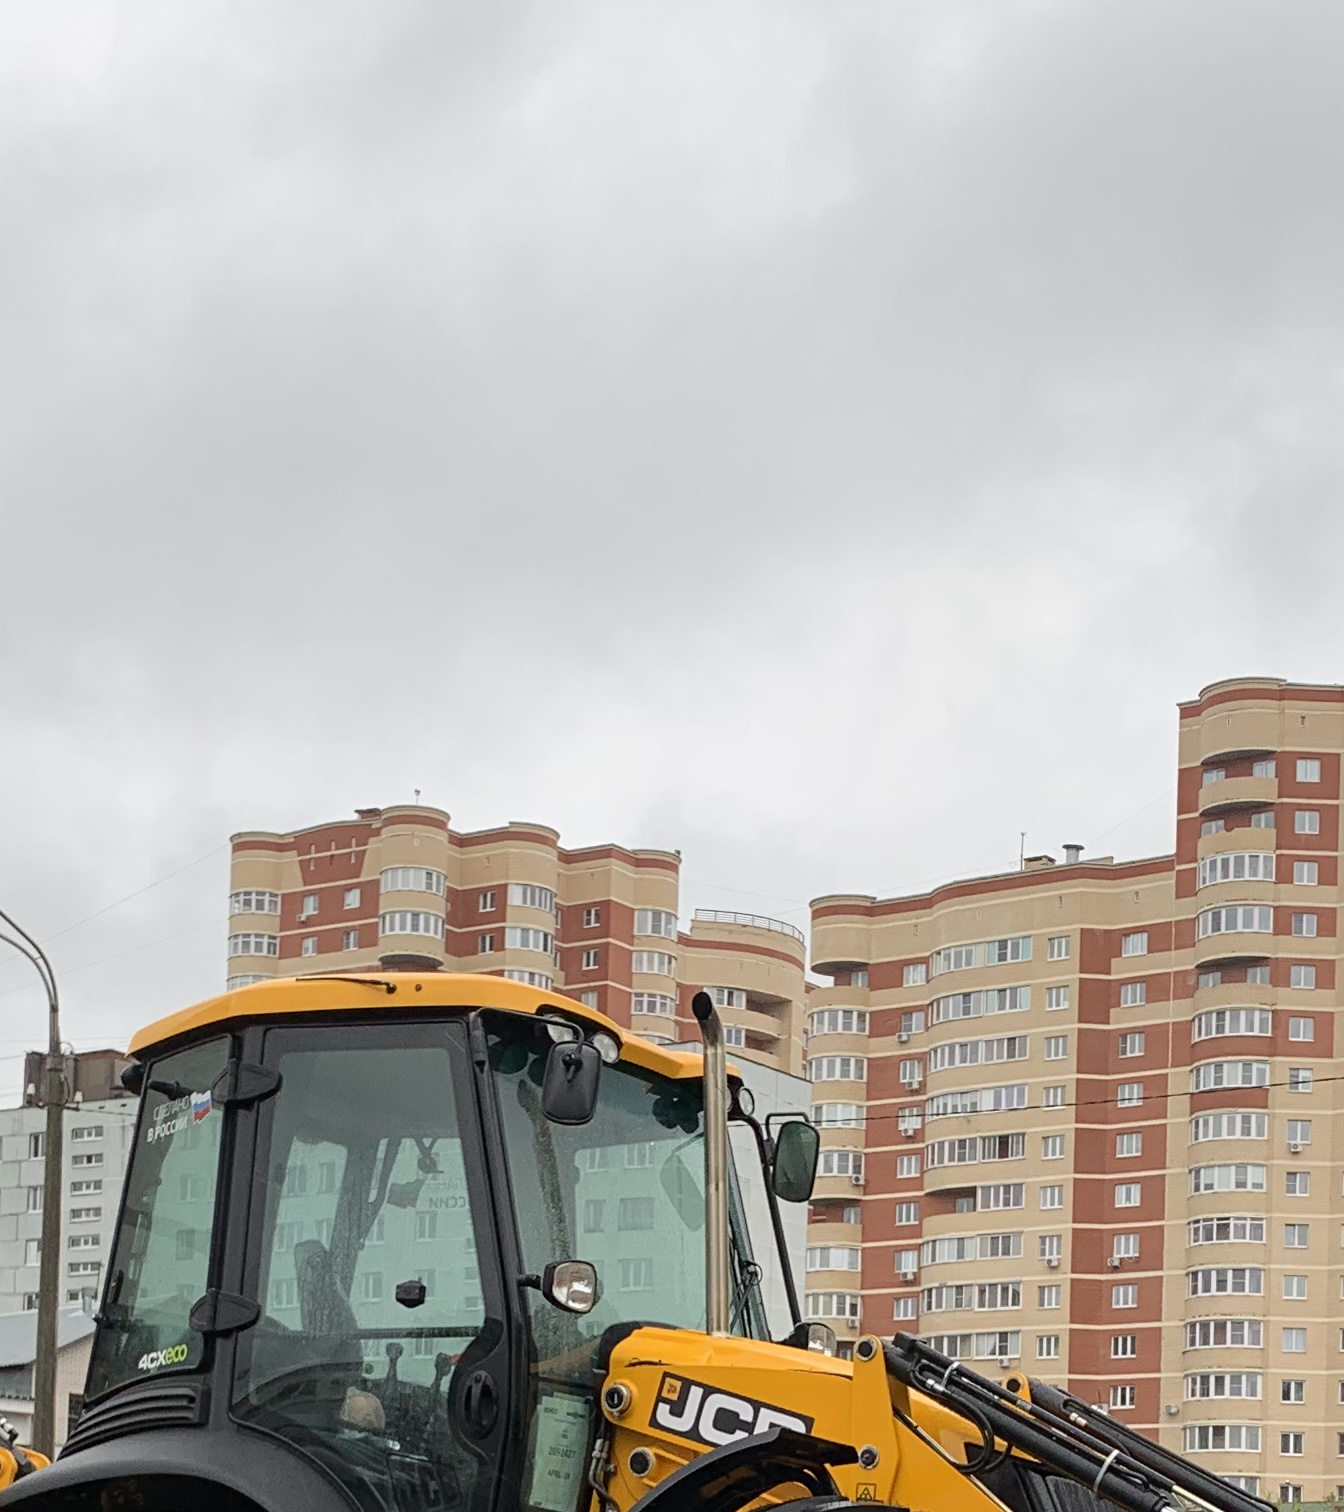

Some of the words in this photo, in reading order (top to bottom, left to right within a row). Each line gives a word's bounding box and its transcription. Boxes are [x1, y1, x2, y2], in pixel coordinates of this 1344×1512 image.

[147, 1128, 154, 1142] В
[155, 1116, 188, 1141] РОССИИ
[138, 1344, 188, 1370] 4CXeco
